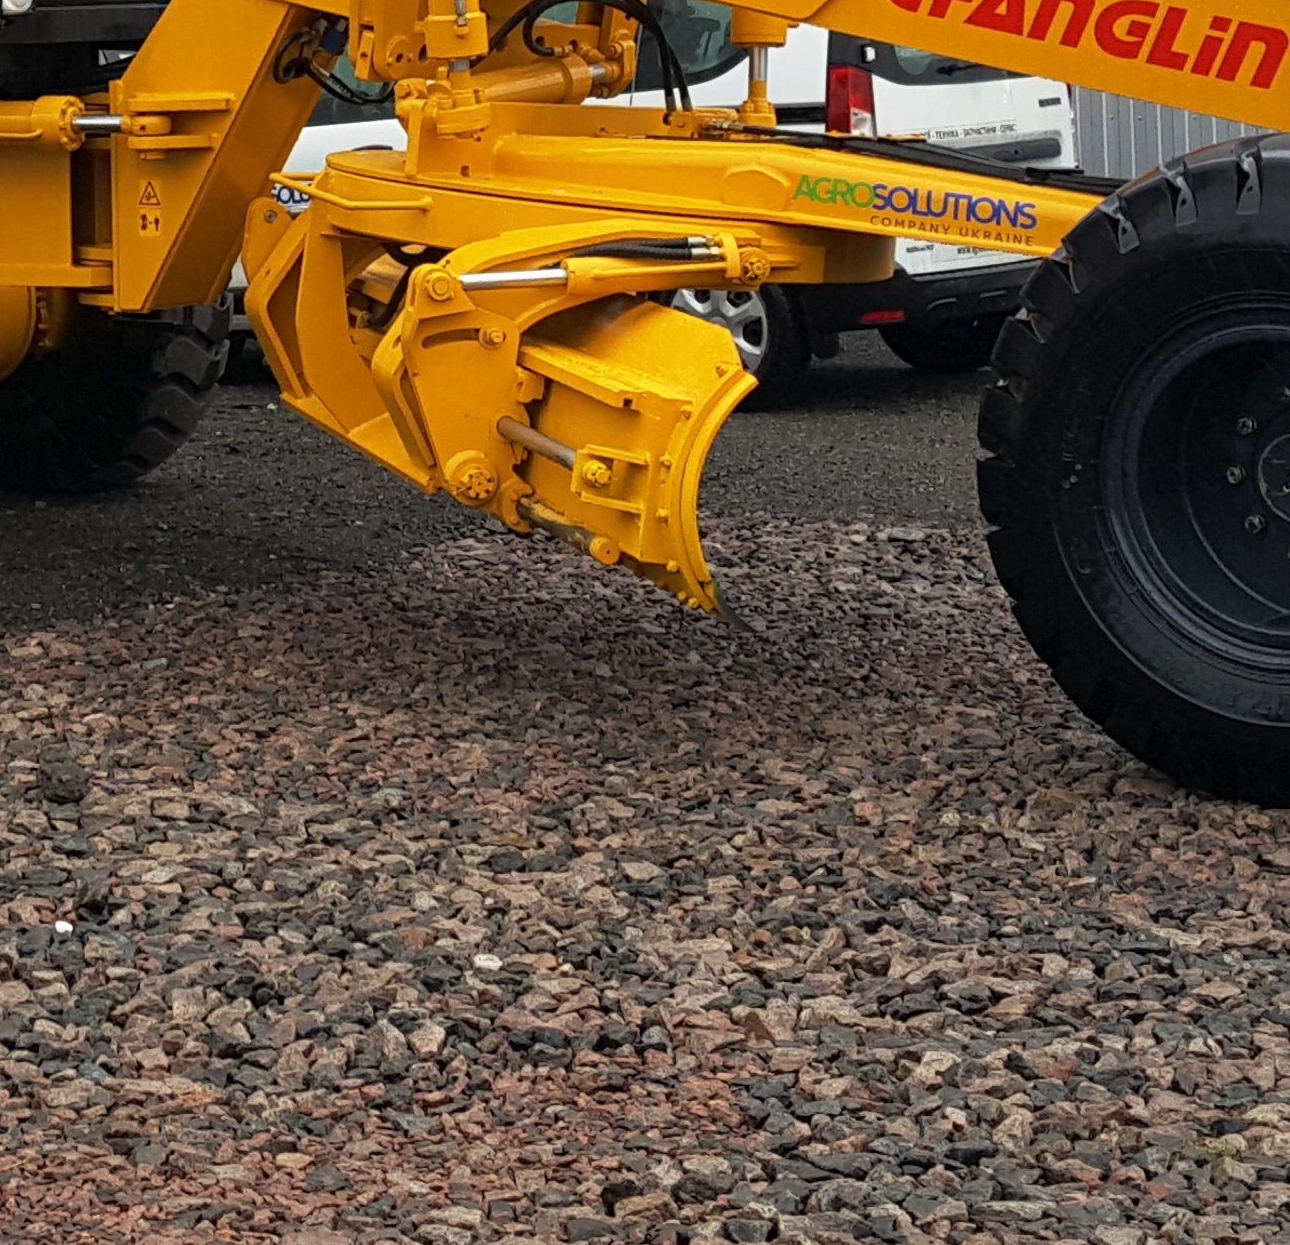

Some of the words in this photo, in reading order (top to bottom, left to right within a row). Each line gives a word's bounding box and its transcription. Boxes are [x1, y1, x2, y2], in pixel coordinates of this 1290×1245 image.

[792, 174, 1037, 230] AGROSOLUTIONS
[870, 215, 952, 235] COMPANY
[959, 226, 1035, 247] UKRAINE
